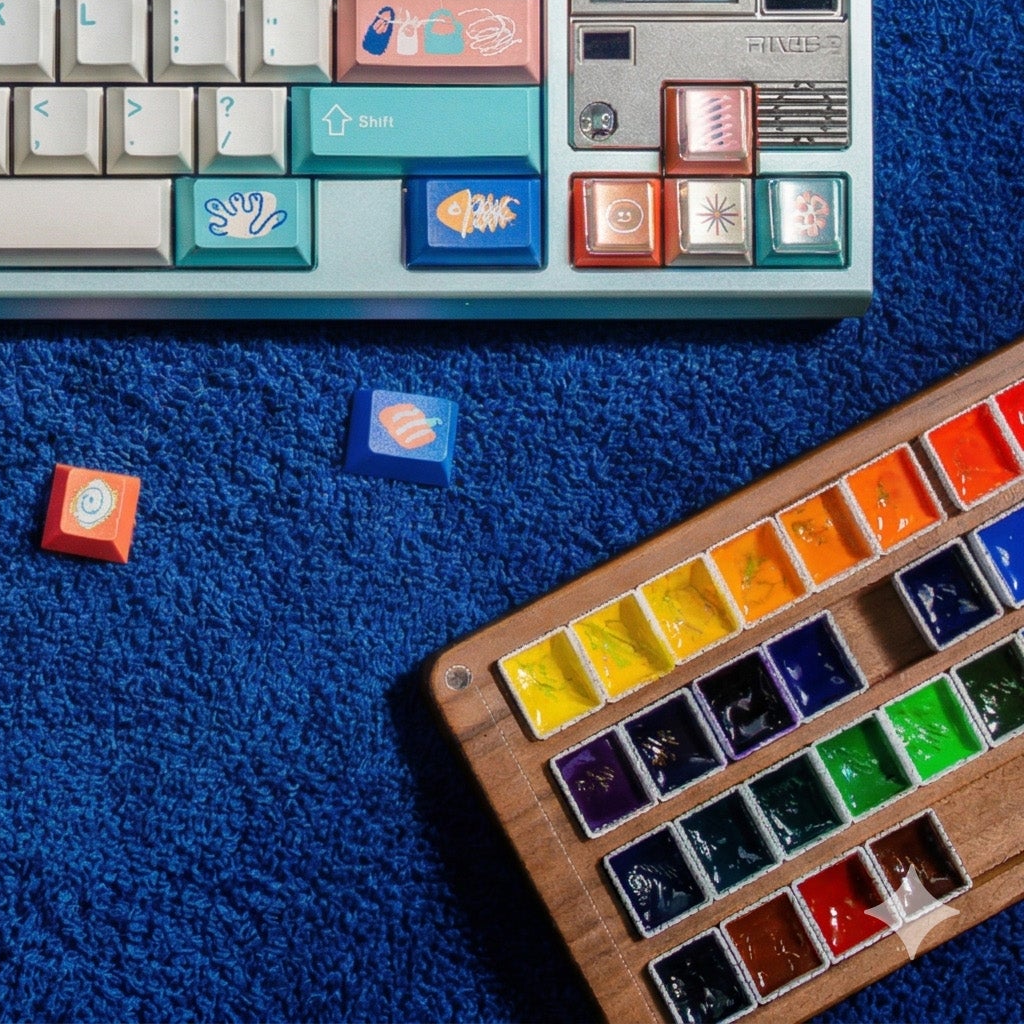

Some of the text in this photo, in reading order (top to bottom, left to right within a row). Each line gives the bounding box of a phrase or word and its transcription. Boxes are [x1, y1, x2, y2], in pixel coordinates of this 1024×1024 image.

[80, 4, 96, 26] L
[34, 101, 48, 116] <
[128, 99, 142, 117] >
[220, 96, 235, 117] ?
[358, 114, 395, 129] Shift
[222, 133, 230, 147] /
